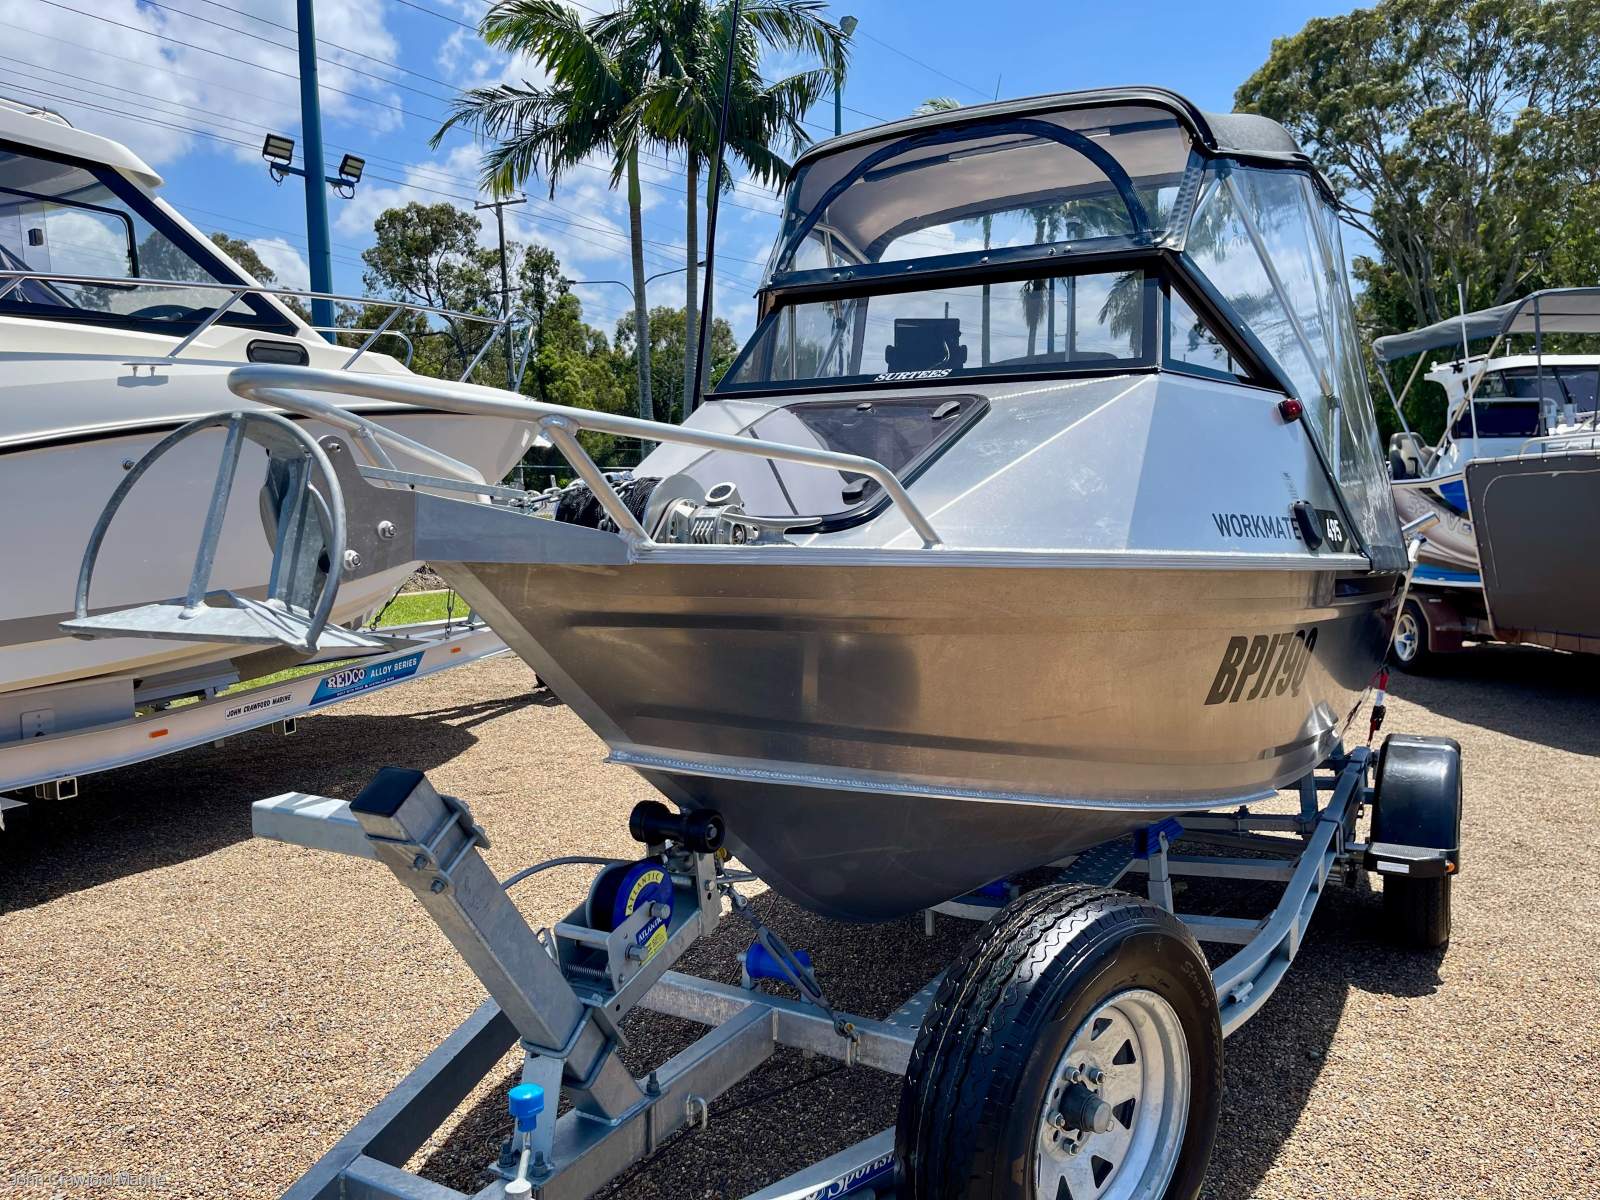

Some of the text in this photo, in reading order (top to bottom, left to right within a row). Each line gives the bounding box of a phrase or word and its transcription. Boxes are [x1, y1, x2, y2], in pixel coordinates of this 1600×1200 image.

[873, 368, 953, 382] SURTEES
[1211, 512, 1343, 542] WORKMATE 495
[327, 668, 366, 689] REDCO
[370, 665, 392, 678] ALLOY
[394, 658, 417, 672] SERIES
[1203, 626, 1318, 706] BPJ79Q
[226, 694, 292, 718] JOHN CRAWFORD MARINE
[627, 872, 661, 911] ATLANTIC
